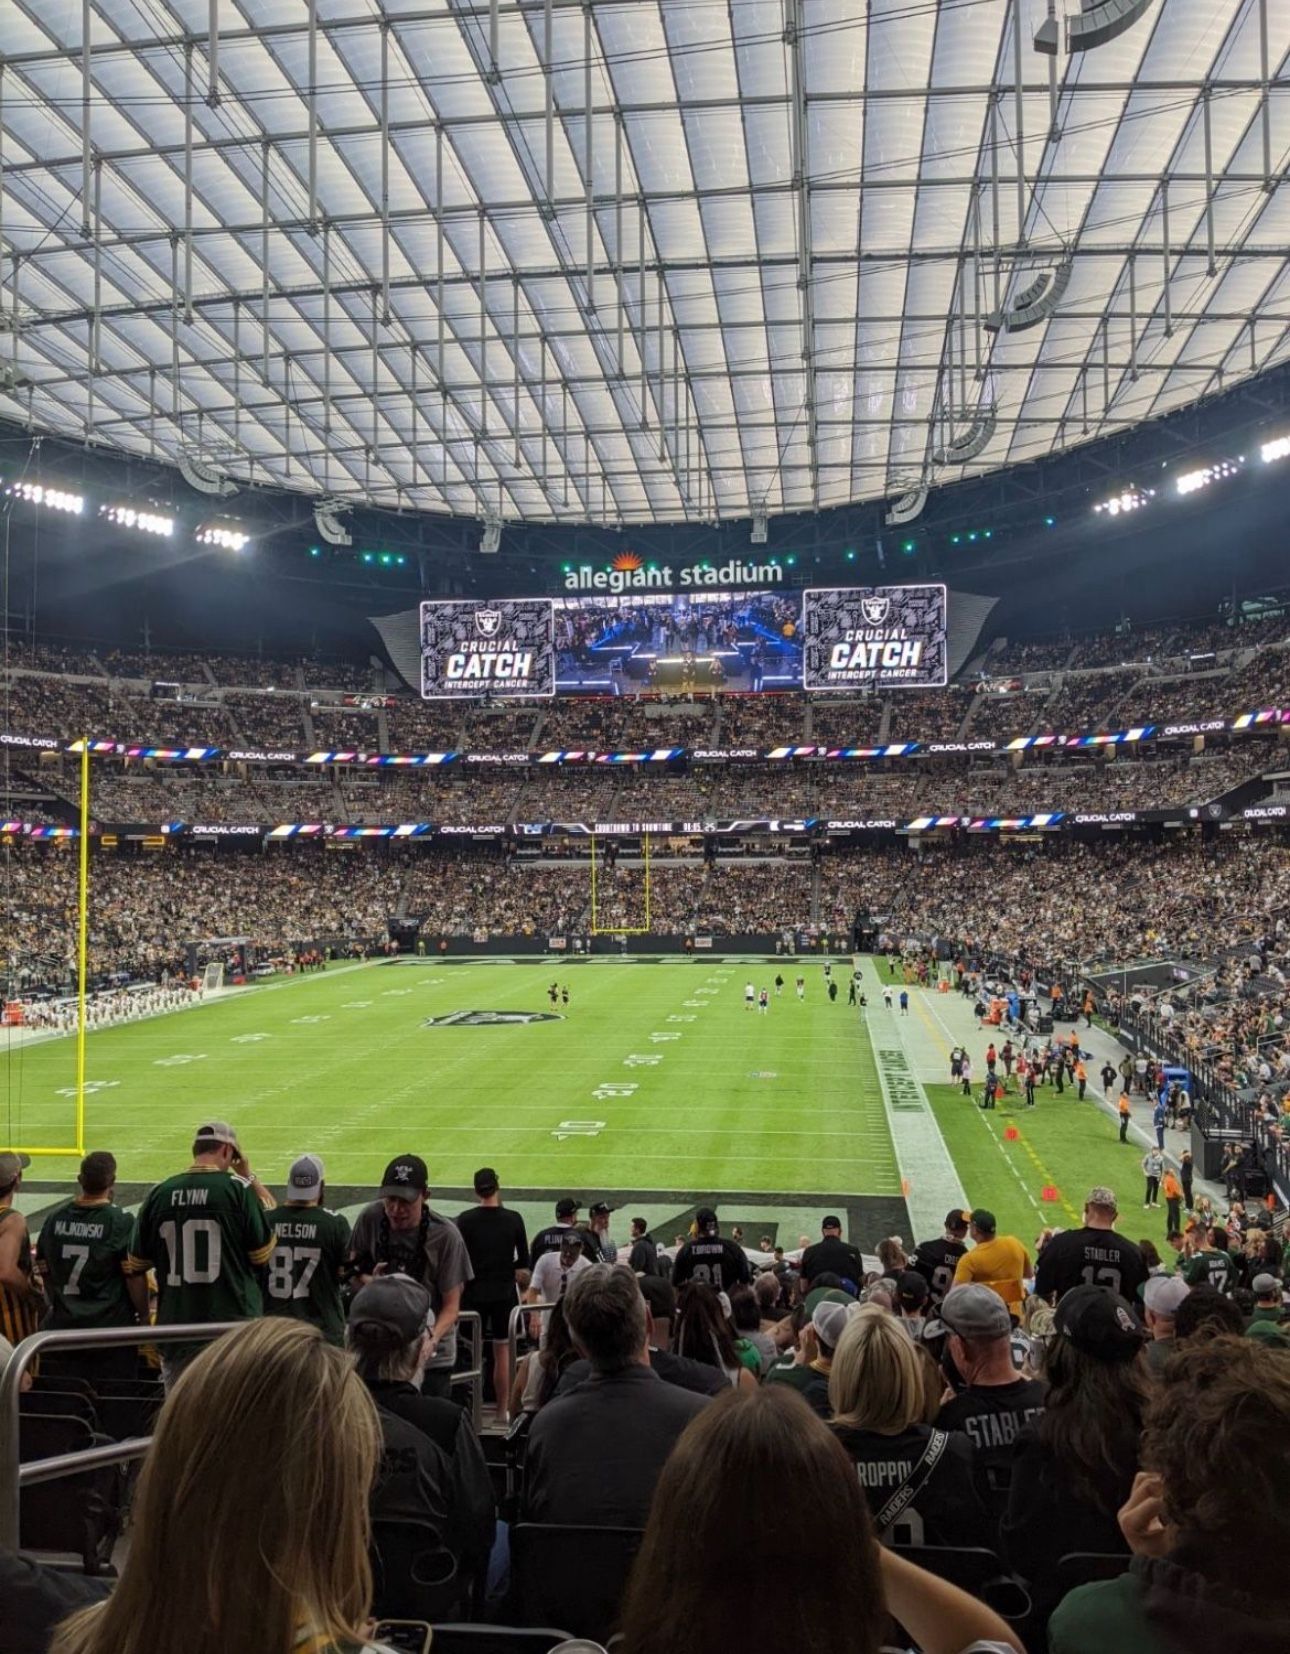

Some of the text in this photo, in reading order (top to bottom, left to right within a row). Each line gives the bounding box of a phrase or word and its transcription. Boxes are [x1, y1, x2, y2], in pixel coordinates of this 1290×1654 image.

[565, 560, 782, 593] allegiant stadium
[845, 628, 908, 641] CRUCIAL
[460, 640, 519, 653] CRUCIAL
[830, 641, 923, 669] CATCH
[446, 653, 532, 679] CATCH
[828, 669, 917, 680] INTERCEPT CANCER
[444, 680, 528, 689] INTERCEPT CANCER
[1164, 721, 1225, 735] CRUCIAL CATCH
[0, 735, 58, 748] CRUCIAL CATCH
[930, 742, 995, 751] CRUCIAL CATCH
[229, 751, 295, 760] CRUCIAL CATCH
[827, 820, 896, 828] CRUCIAL CATCH
[1075, 813, 1136, 823] CRUCIAL CATCH
[192, 826, 259, 834] CRUCIAL CATCH
[477, 825, 505, 833] CATCH
[551, 1121, 607, 1139] 10
[171, 1188, 209, 1207] FLYNN
[54, 1221, 104, 1239] MAJKOWSKI
[275, 1222, 317, 1239] NELSON
[159, 1219, 221, 1287] 10
[62, 1244, 89, 1295] 7
[268, 1246, 321, 1299] 87
[924, 1431, 945, 1466] RAIDERS
[879, 1485, 914, 1526] RAIDERS
